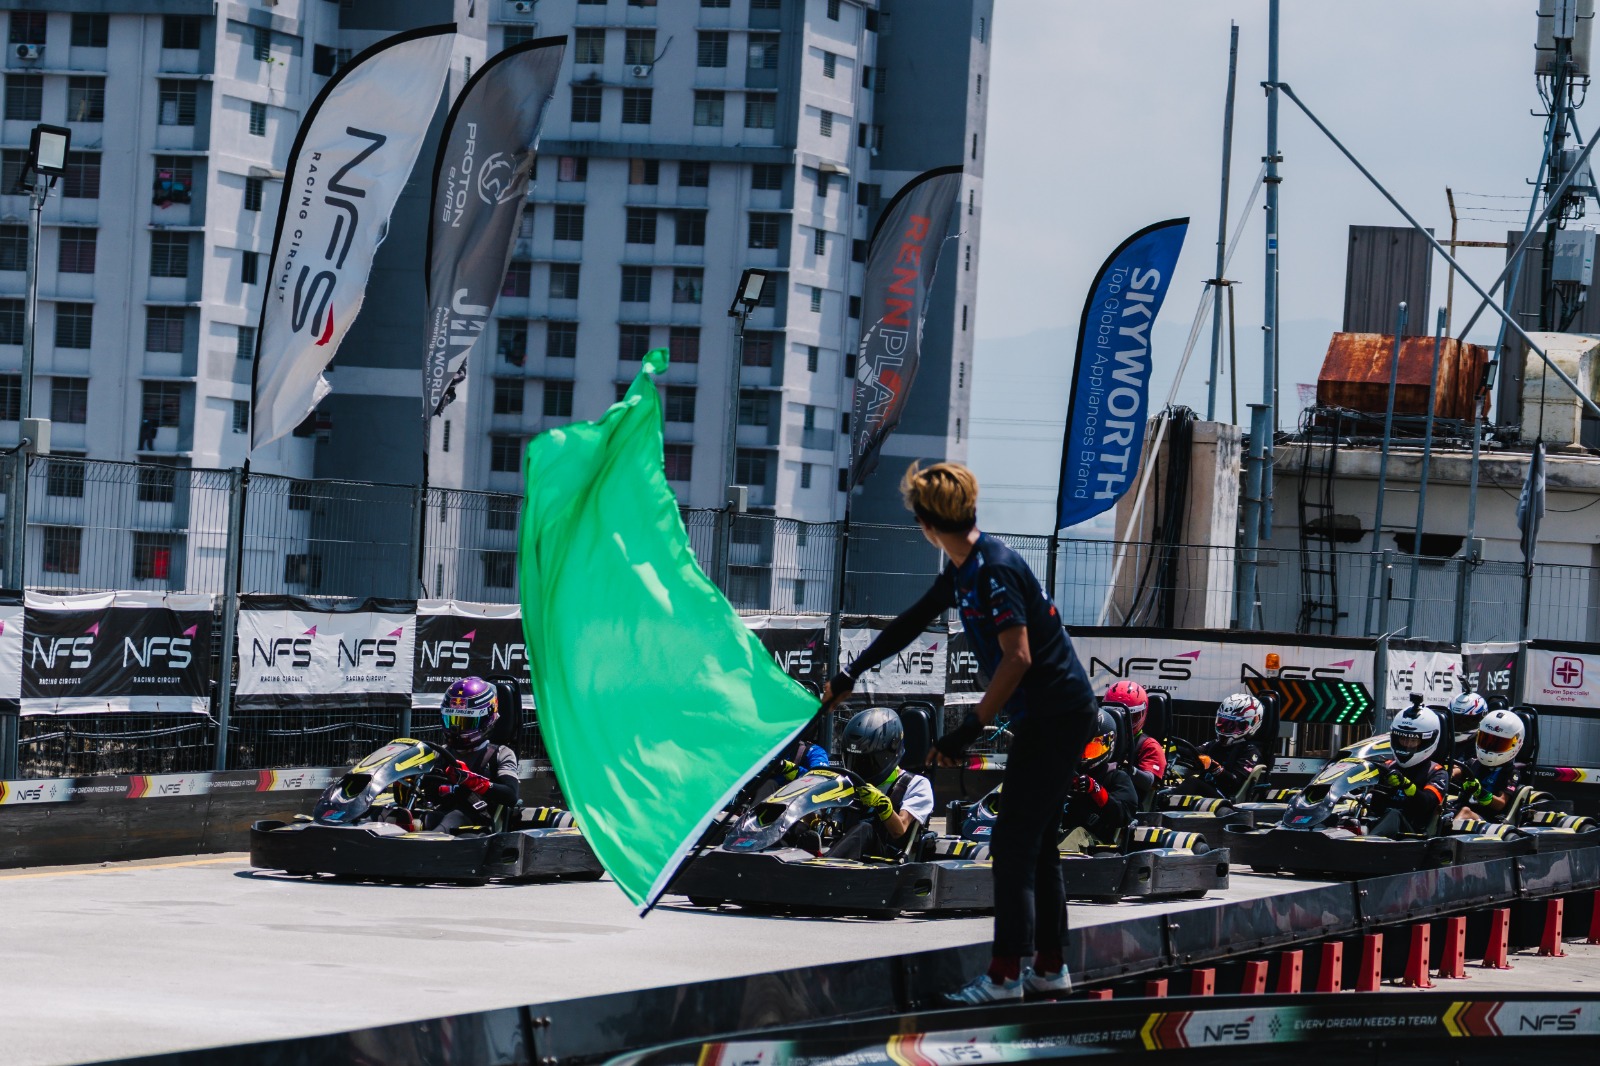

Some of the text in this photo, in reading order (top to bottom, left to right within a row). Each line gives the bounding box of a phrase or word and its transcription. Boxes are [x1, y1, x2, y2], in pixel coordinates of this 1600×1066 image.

[451, 122, 477, 228] PROTON
[278, 151, 322, 304] RACING CIRCUIT
[292, 126, 387, 338] NFS
[1075, 266, 1129, 499] Top Global Appliances Brand
[1093, 267, 1161, 501] SKYWORTH
[31, 636, 94, 669] NFS
[123, 636, 192, 669] NFS
[252, 637, 312, 668] NFS
[337, 638, 398, 668] NFS
[420, 640, 471, 670] NFS
[774, 650, 813, 674] NFS
[896, 651, 934, 674] NFS
[949, 651, 979, 674] NFS
[157, 676, 181, 684] CIRCUIT
[1089, 657, 1192, 681] NFS
[1389, 669, 1414, 691] NFS
[1487, 669, 1511, 691] NFS
[1423, 671, 1454, 692] NFS
[1393, 730, 1420, 739] HONDA
[158, 783, 181, 794] NFS
[283, 777, 302, 788] NFS
[17, 790, 42, 801] NFS
[1203, 1022, 1250, 1042] NFS
[1294, 1015, 1438, 1030] EVERY DREAM NEEDS A TEAM
[1519, 1014, 1577, 1031] NFS
[1038, 1036, 1071, 1048] DREAM
[1071, 1033, 1100, 1044] NEEDS
[1101, 1032, 1109, 1042] A
[1109, 1030, 1136, 1040] TEAM
[939, 1044, 982, 1062] NFS
